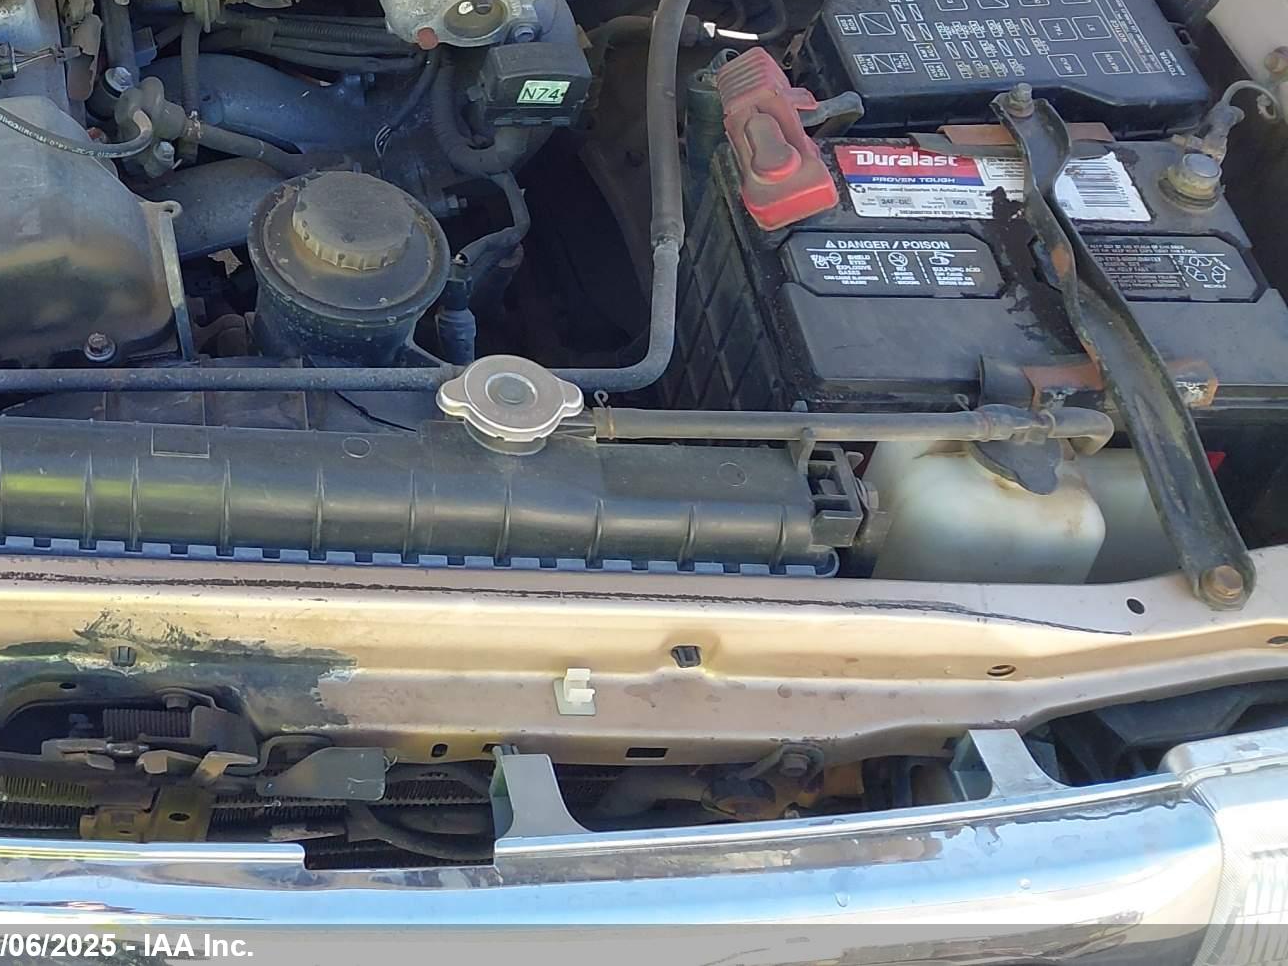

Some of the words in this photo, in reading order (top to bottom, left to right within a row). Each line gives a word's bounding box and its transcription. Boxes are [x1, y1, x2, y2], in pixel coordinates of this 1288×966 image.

[1109, 19, 1128, 42] NOTICE
[521, 87, 560, 100] N74
[849, 150, 959, 166] Duralast
[837, 240, 890, 249] DANGER
[892, 241, 899, 249] /
[902, 241, 950, 249] POISON
